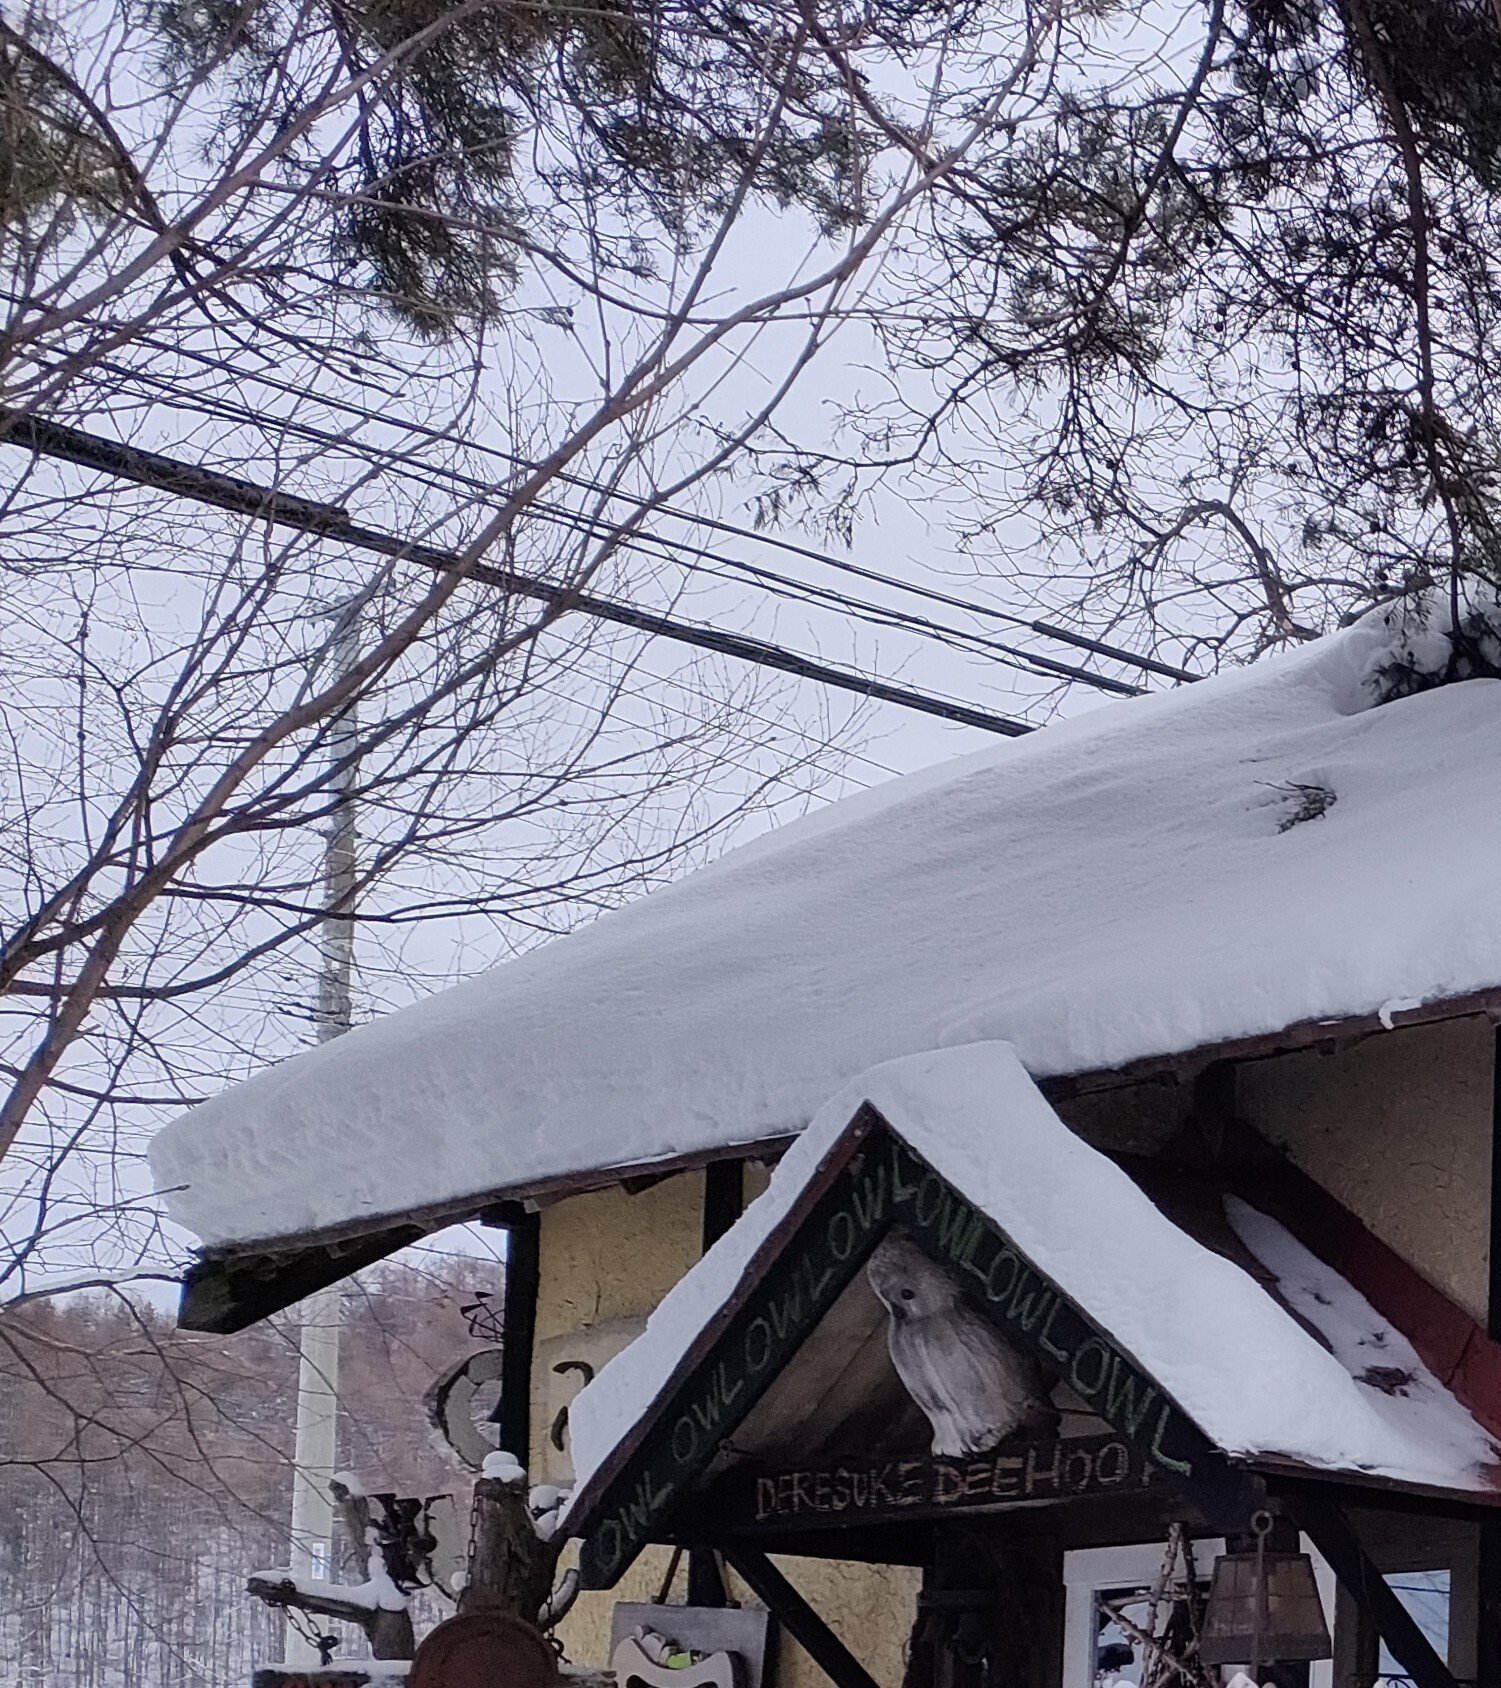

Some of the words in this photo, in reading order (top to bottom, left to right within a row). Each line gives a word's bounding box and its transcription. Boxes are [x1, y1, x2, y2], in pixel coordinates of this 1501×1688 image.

[591, 1468, 676, 1572] OWL
[671, 1361, 746, 1466] OWL
[744, 1251, 837, 1375] OWL
[827, 1145, 919, 1261] OWL
[915, 1172, 990, 1290] OWL
[985, 1249, 1070, 1365] OWL
[1071, 1335, 1193, 1479] OWL
